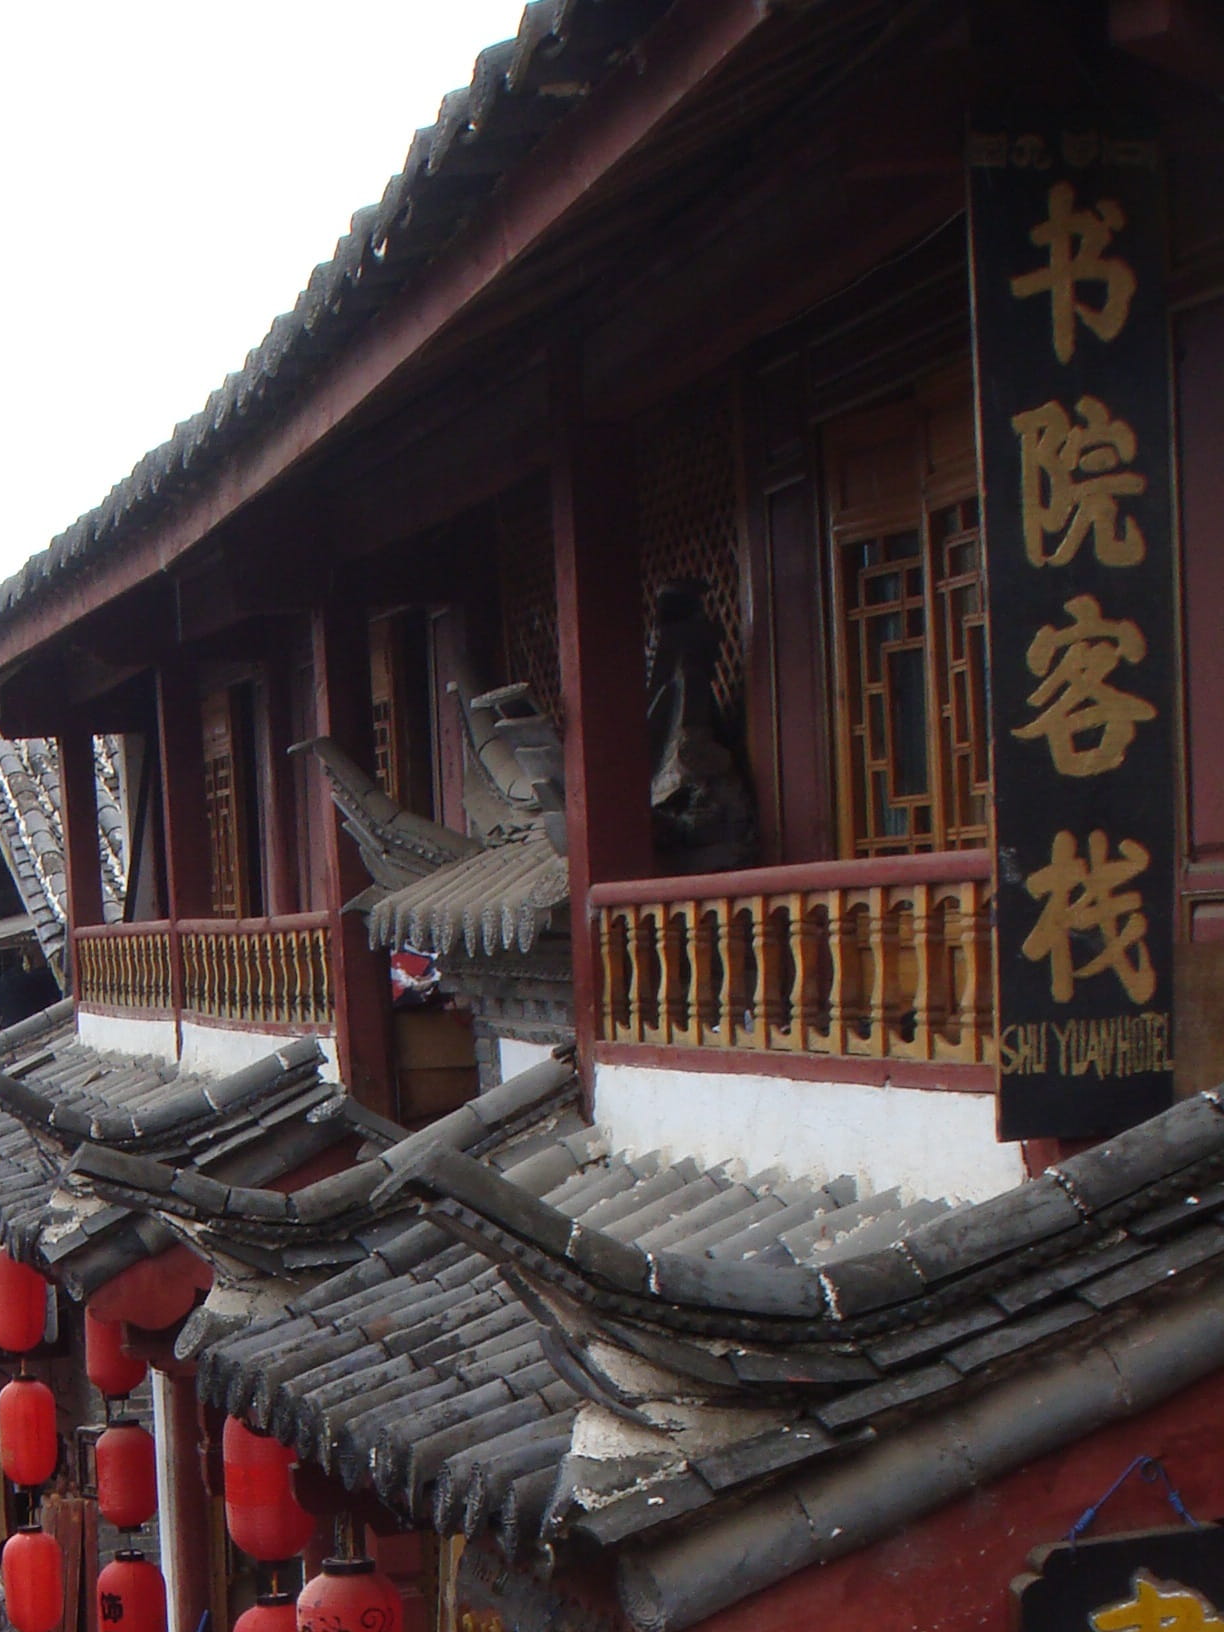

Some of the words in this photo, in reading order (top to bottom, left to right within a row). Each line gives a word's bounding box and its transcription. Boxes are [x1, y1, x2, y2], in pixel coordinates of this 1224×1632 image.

[1009, 182, 1158, 1005] 书院客栈
[999, 1022, 1047, 1076] SHU
